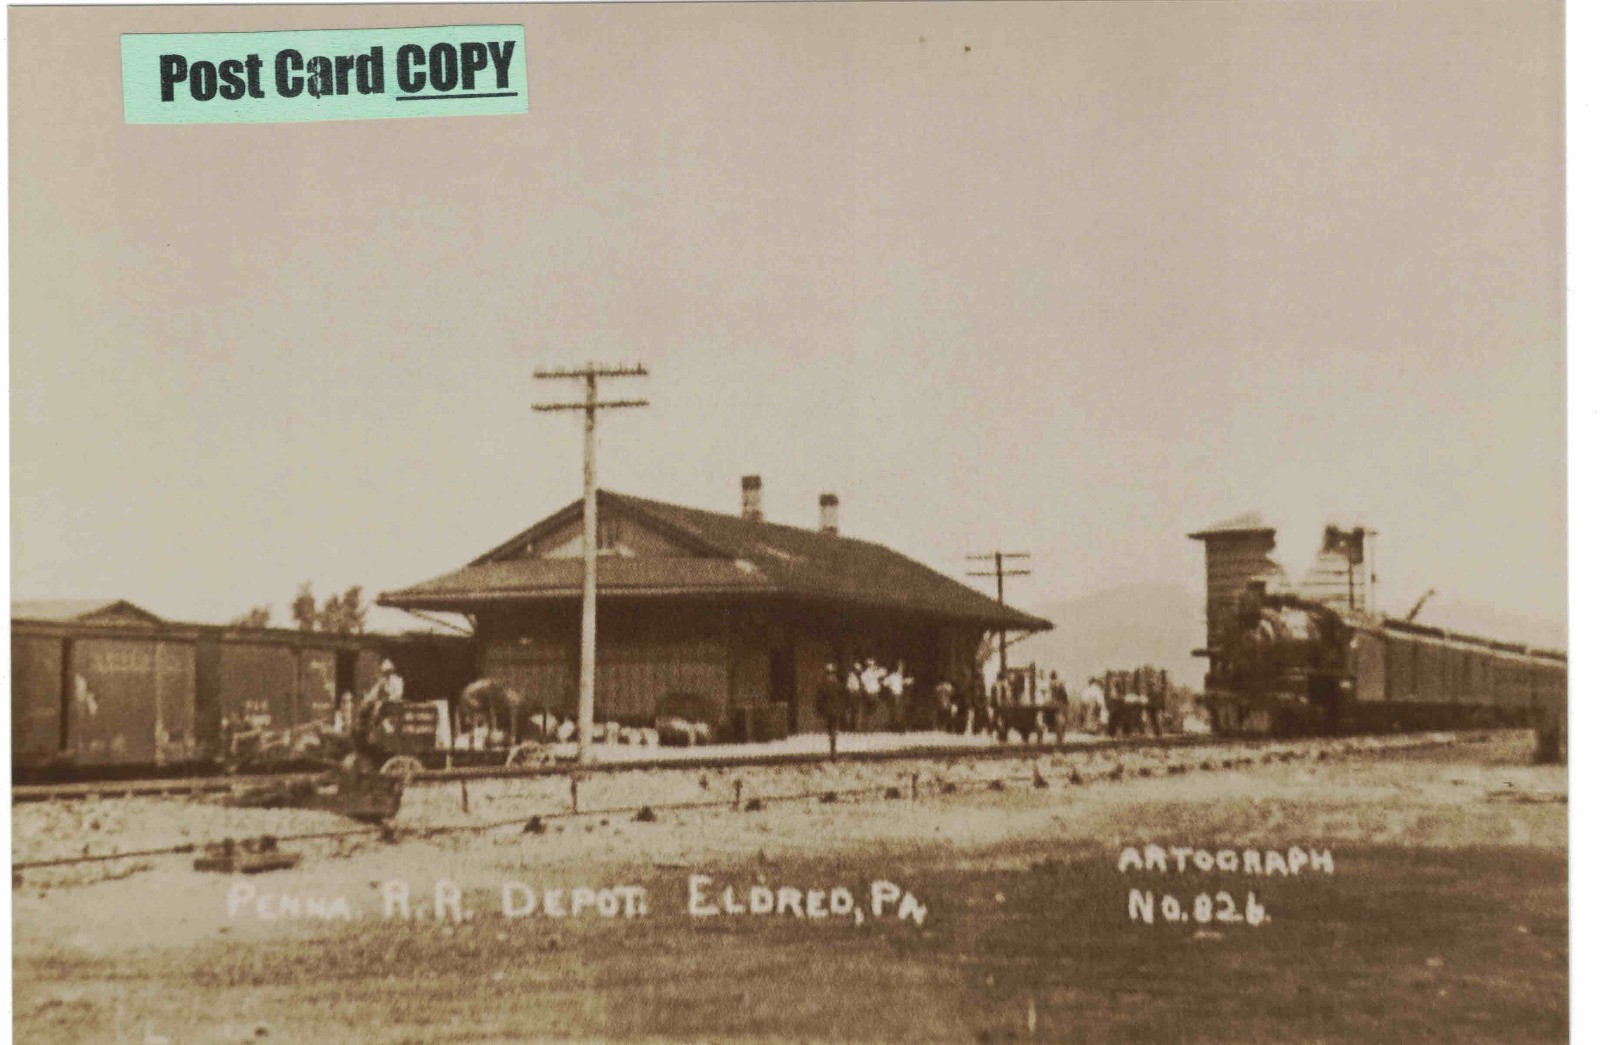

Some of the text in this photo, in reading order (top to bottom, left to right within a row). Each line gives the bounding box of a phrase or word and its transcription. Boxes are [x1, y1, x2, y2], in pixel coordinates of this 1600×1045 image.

[160, 41, 517, 101] Post Card COPY
